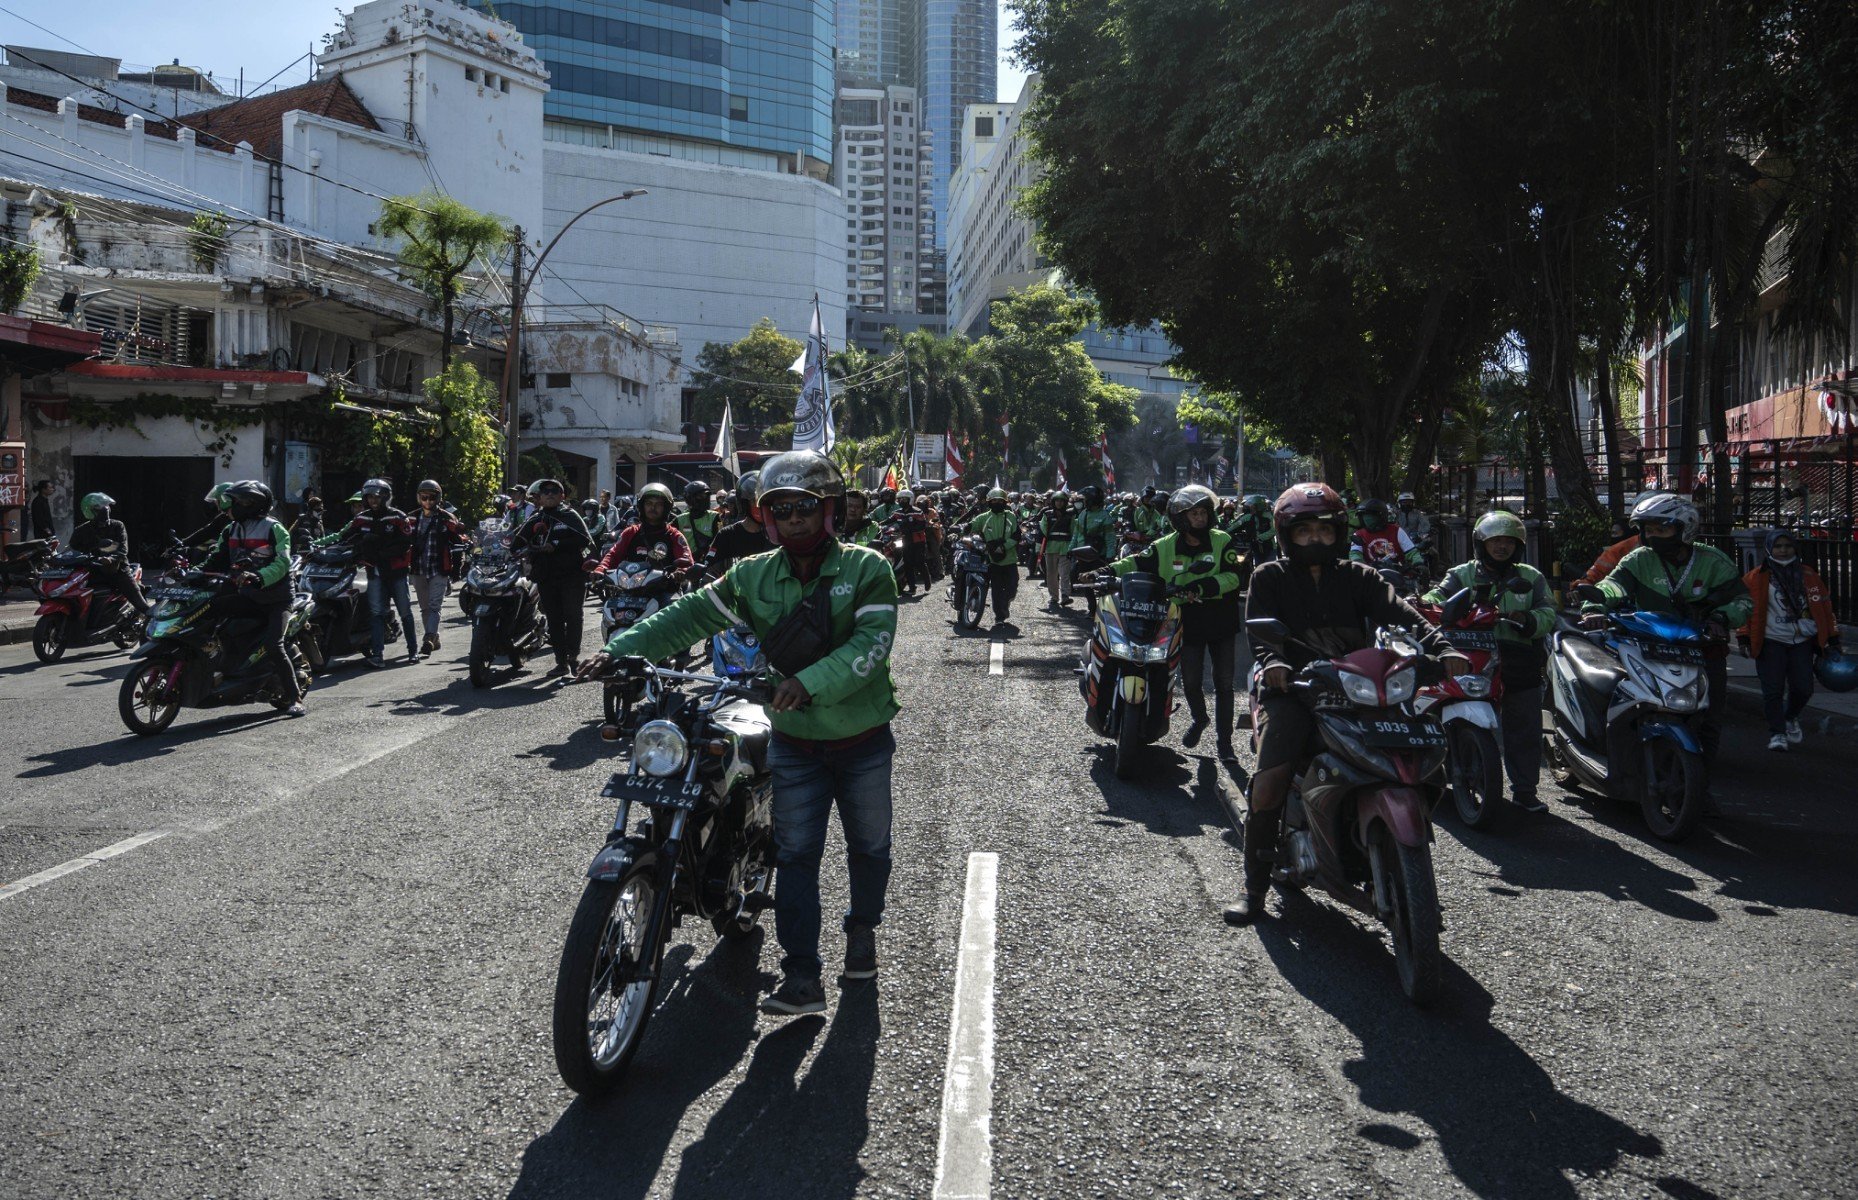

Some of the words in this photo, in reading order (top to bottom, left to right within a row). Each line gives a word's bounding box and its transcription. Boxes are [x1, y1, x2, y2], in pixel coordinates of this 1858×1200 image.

[830, 581, 853, 596] rab
[852, 631, 891, 677] Grab
[1374, 721, 1410, 734] 5039
[1423, 724, 1442, 735] NL
[626, 776, 667, 791] 6474
